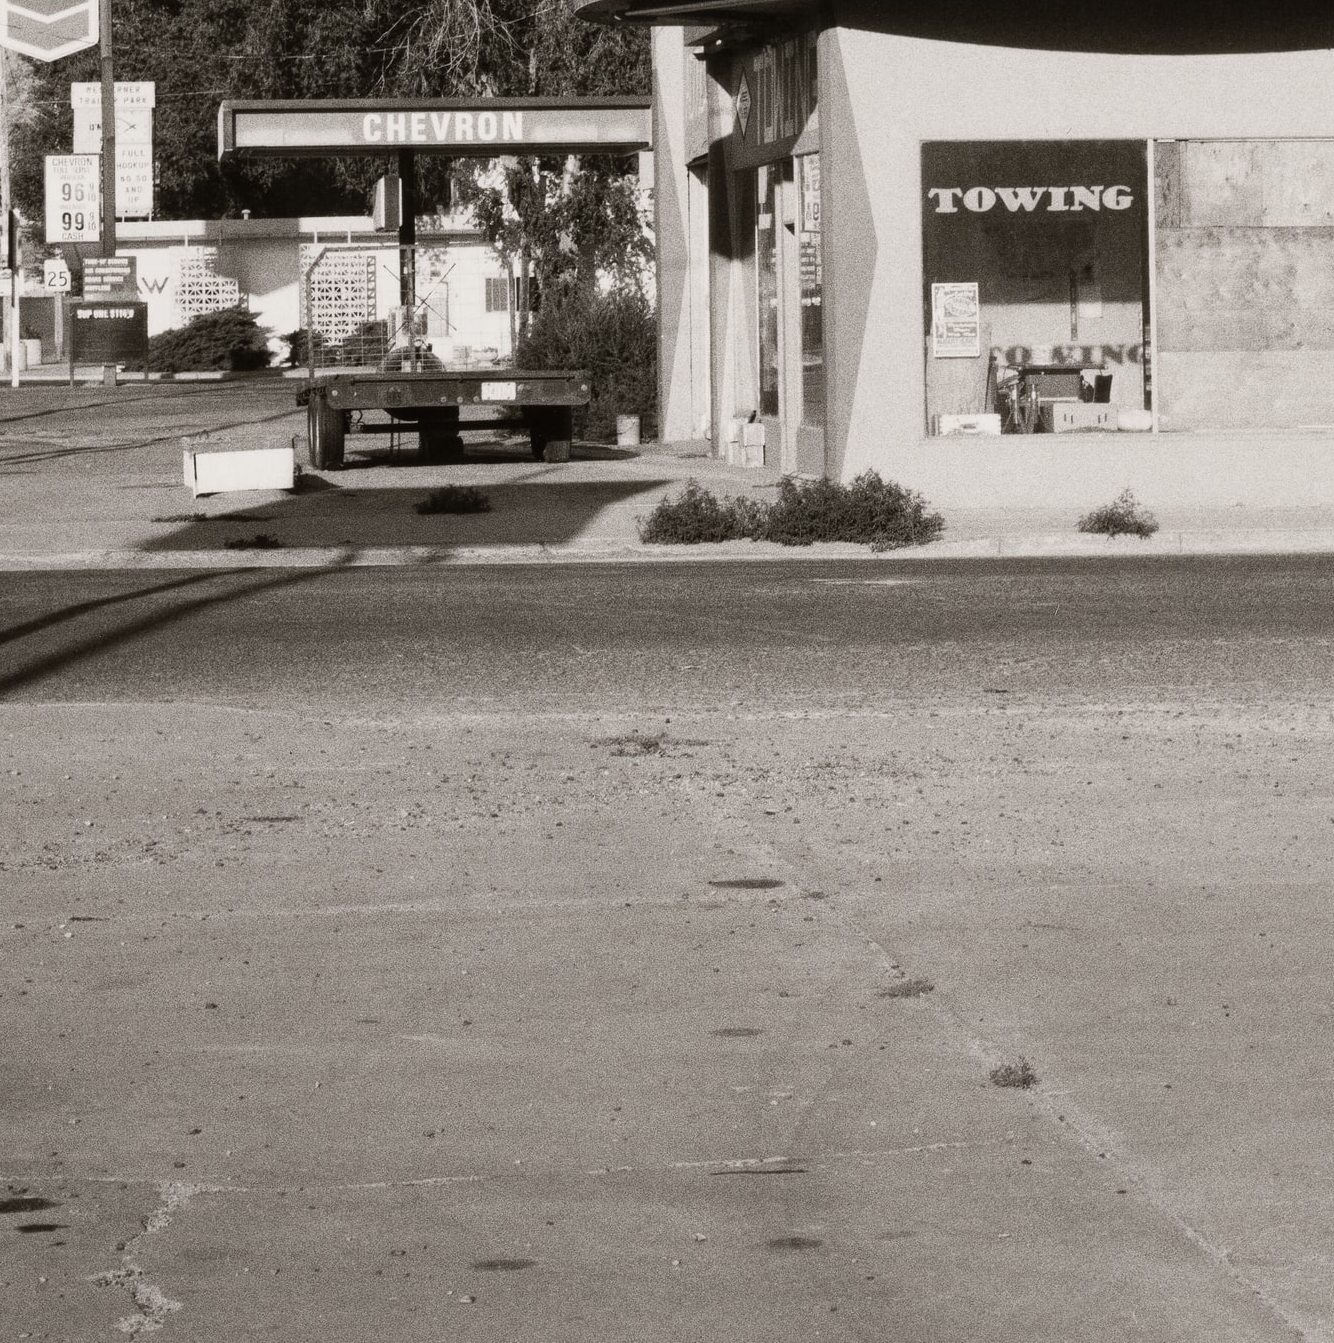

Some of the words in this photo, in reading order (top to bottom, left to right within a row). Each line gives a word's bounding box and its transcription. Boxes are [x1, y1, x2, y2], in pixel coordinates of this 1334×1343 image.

[362, 111, 524, 143] CHEVRON
[122, 149, 146, 158] FULL
[51, 157, 93, 167] CHEVRON
[61, 183, 85, 202] 96
[125, 186, 143, 194] AND
[927, 184, 1134, 213] TOWING
[61, 211, 85, 232] 99
[61, 233, 85, 241] CASH
[48, 271, 68, 287] 25
